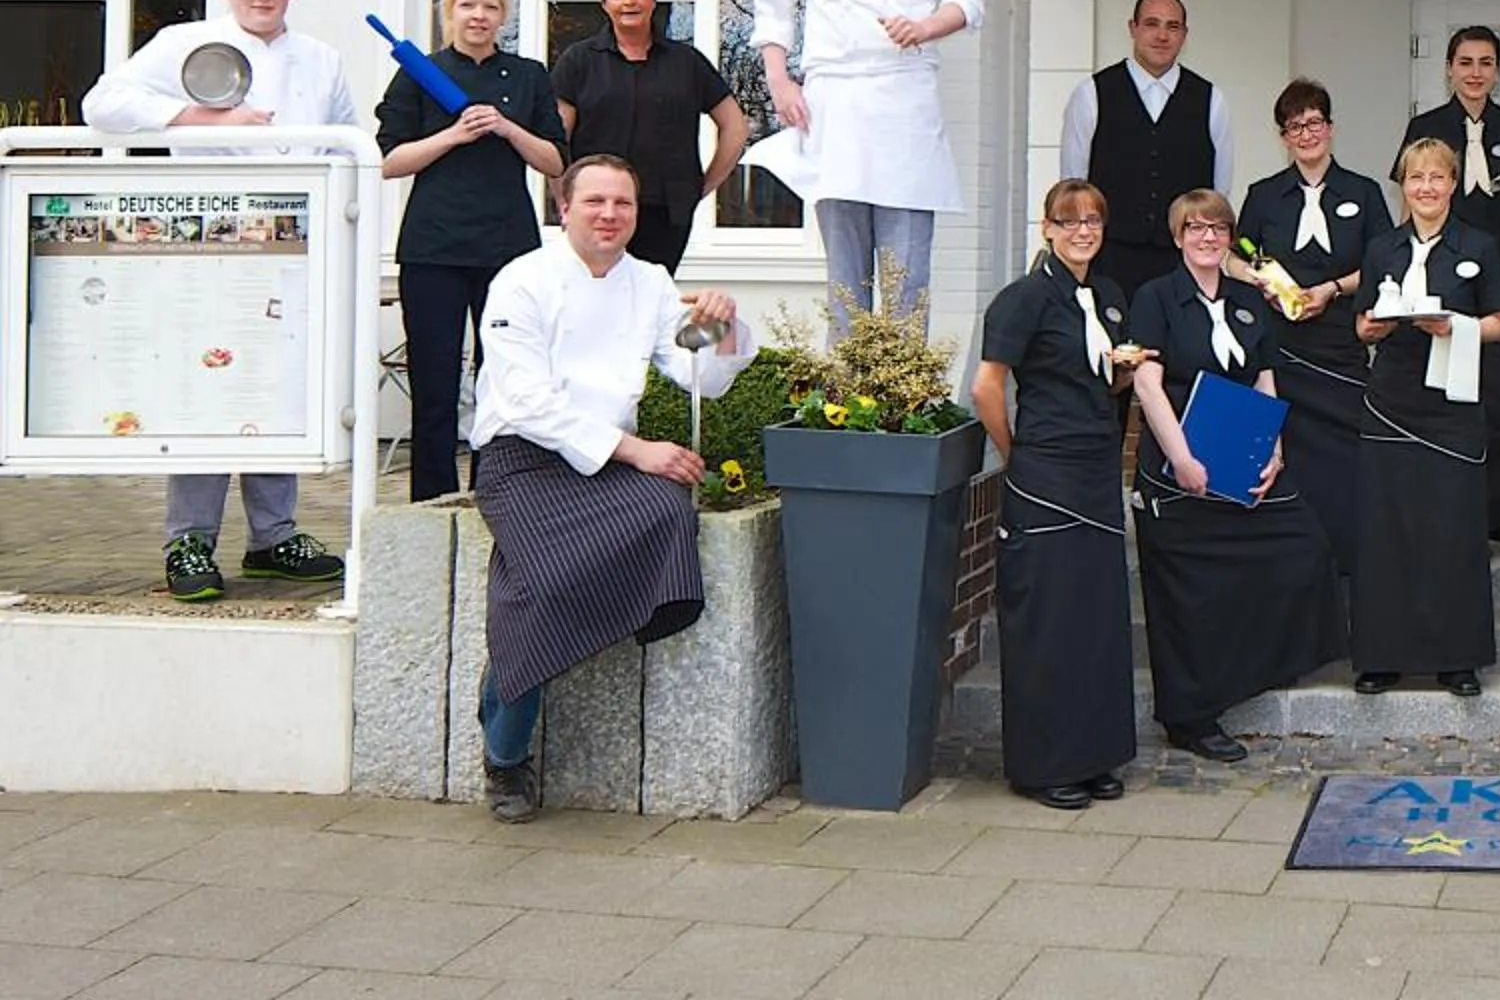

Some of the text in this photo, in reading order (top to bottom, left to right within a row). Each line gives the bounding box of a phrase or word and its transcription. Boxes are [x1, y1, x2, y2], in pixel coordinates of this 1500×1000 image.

[84, 195, 307, 213] Hotel DEUTSCHE EICHE Restaurant
